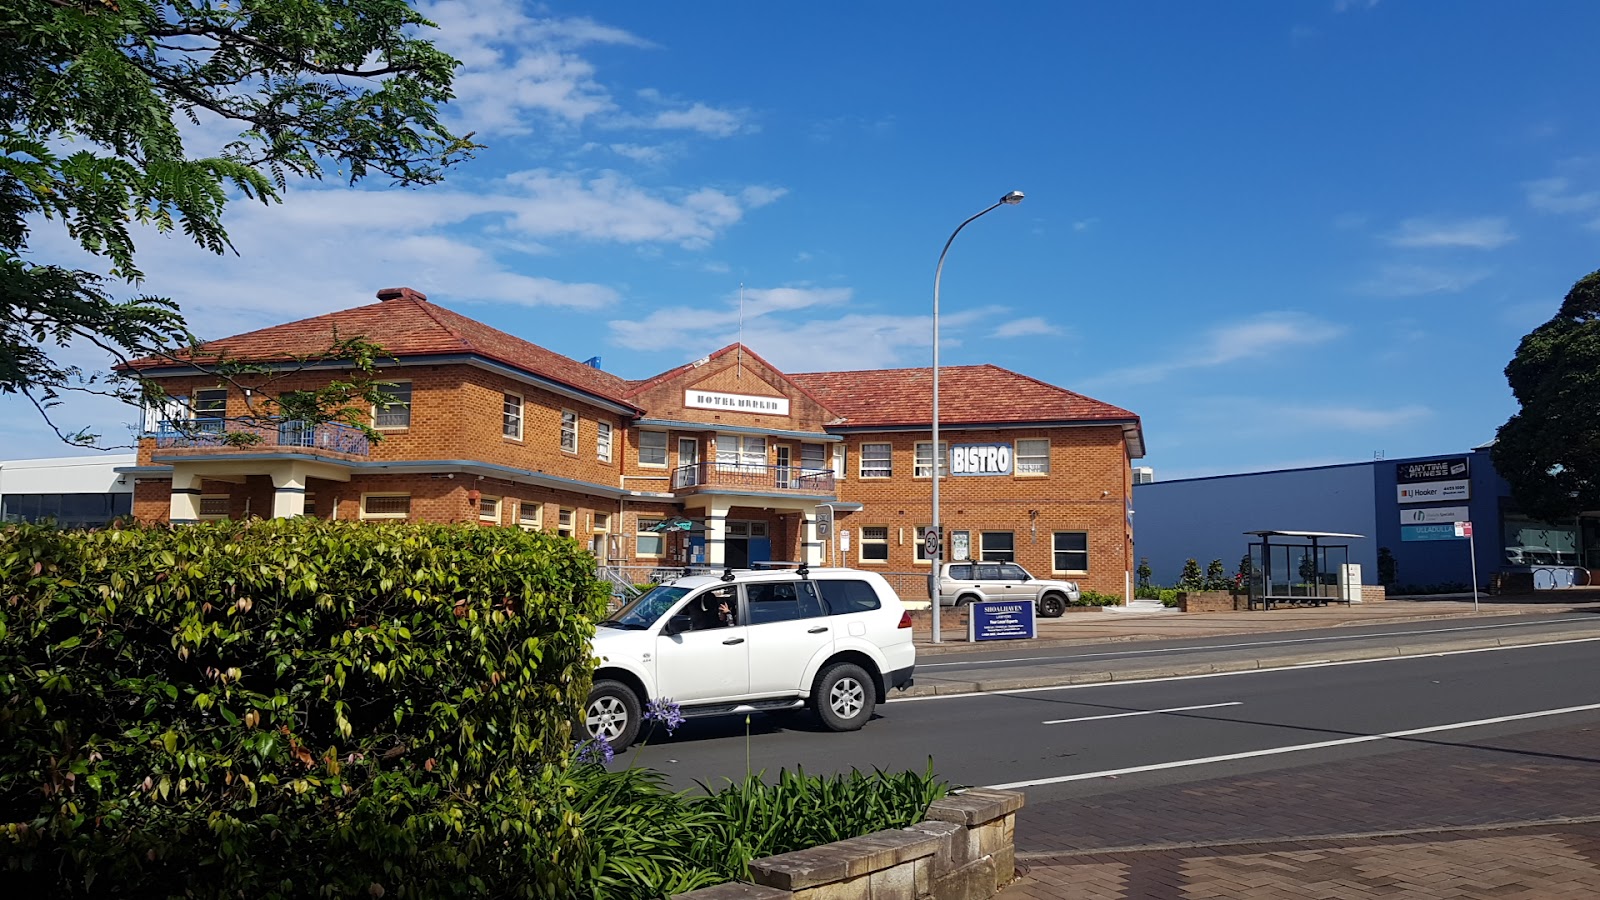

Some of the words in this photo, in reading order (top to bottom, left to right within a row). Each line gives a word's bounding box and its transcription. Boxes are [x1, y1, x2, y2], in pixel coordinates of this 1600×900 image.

[697, 395, 735, 406] HOTEL
[953, 446, 1009, 473] BISTRO
[1409, 462, 1448, 473] ANYTIME
[1409, 470, 1448, 478] FITNESS
[1408, 490, 1413, 498] LJ
[1415, 488, 1437, 496] Hooker
[820, 524, 826, 533] 7
[927, 537, 936, 548] 50
[984, 605, 1023, 613] SHOALHAVEN
